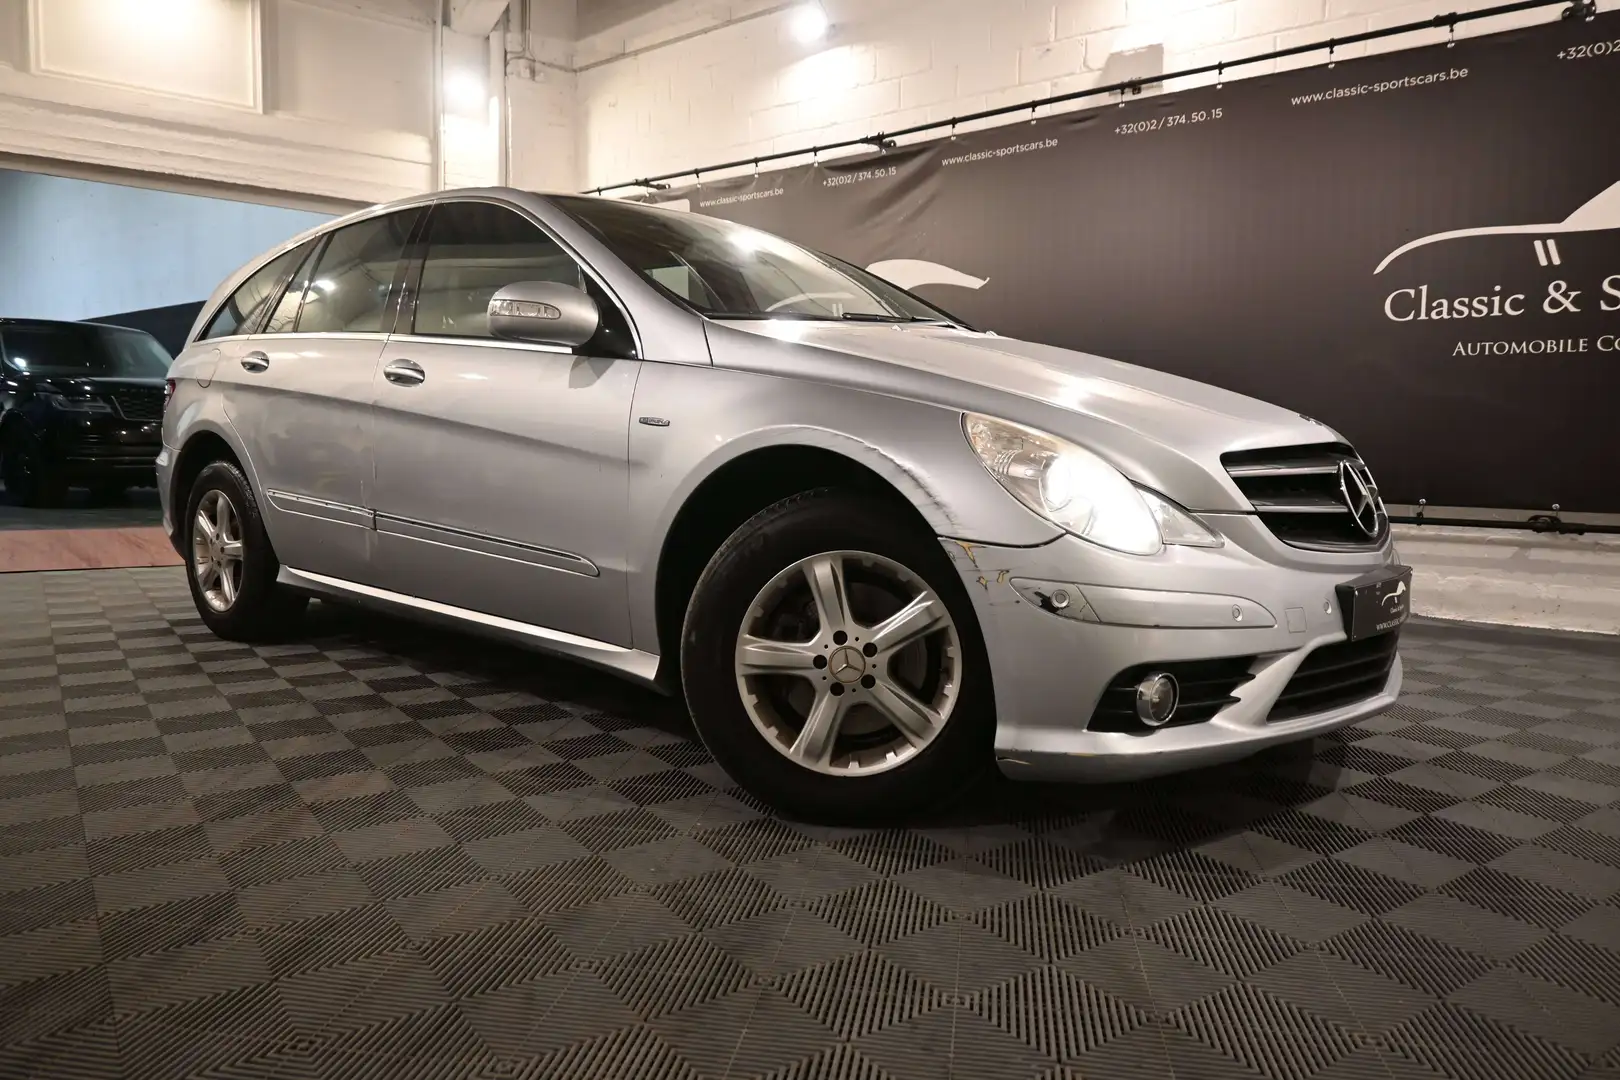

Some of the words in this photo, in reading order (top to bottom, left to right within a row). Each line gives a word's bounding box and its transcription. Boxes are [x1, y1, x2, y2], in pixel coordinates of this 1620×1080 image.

[1291, 66, 1469, 106] www.classic-sportscars.be
[941, 137, 1059, 167] www.classic-sportscars.be
[699, 187, 784, 208] www.classic-sportscars.be
[1384, 284, 1526, 322] Classic
[1542, 280, 1582, 315] &
[1452, 338, 1589, 356] AUTOMOBILE
